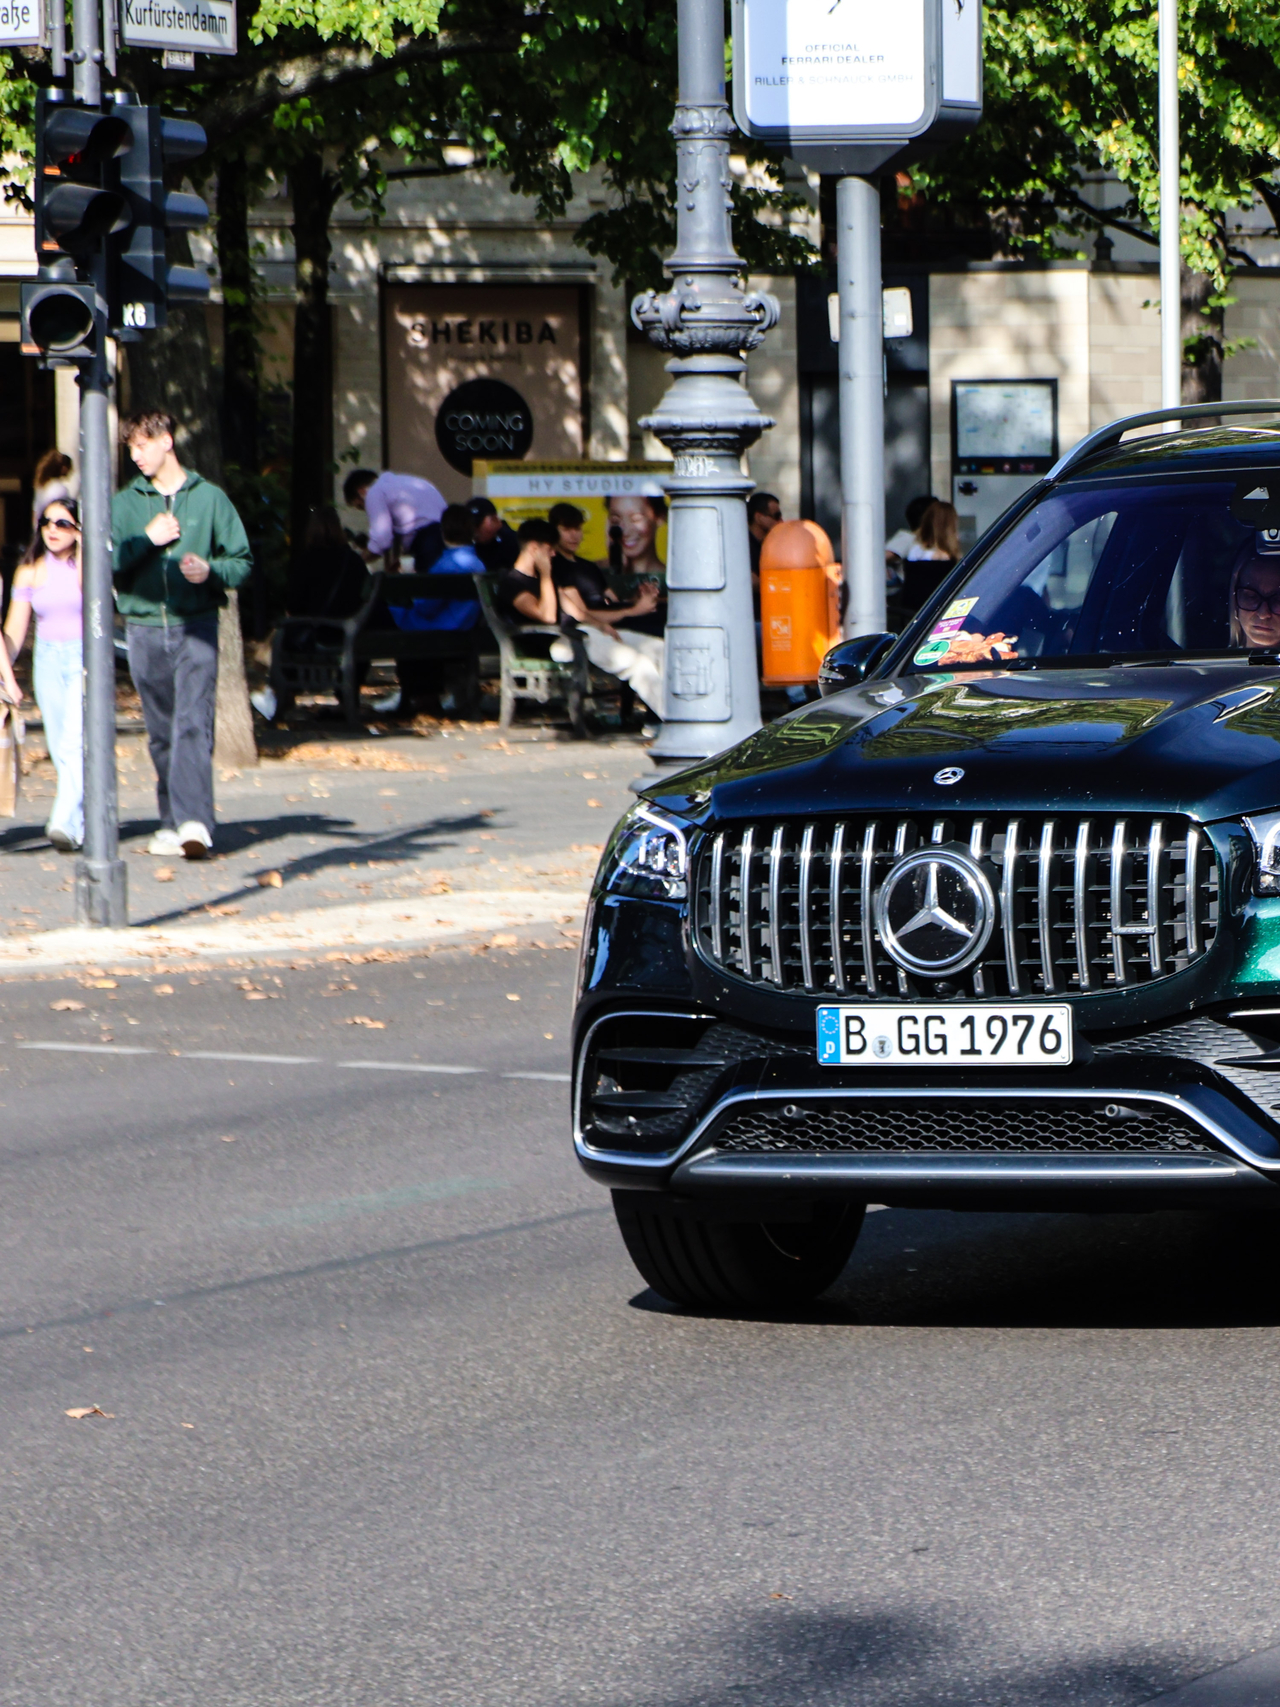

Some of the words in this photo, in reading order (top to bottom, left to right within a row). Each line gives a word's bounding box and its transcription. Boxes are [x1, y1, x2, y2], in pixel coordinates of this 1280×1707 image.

[0, 0, 30, 31] aße
[126, 0, 229, 35] Kurfürstendamm
[805, 43, 860, 53] OFFICIAL
[781, 56, 833, 66] FERRARI
[836, 54, 885, 64] DEALER
[754, 76, 794, 86] RILLER
[808, 75, 874, 85] SCHNAUCK
[878, 74, 914, 83] GMBH
[122, 302, 147, 327] K6
[411, 319, 557, 346] SHEKIBA
[445, 413, 524, 432] COMING
[455, 433, 514, 451] SOON
[528, 479, 556, 492] HY
[562, 478, 635, 492] STUDIO
[844, 1014, 868, 1056] B
[896, 1014, 949, 1056] GG
[959, 1013, 1063, 1056] 1976
[825, 1040, 836, 1054] D
